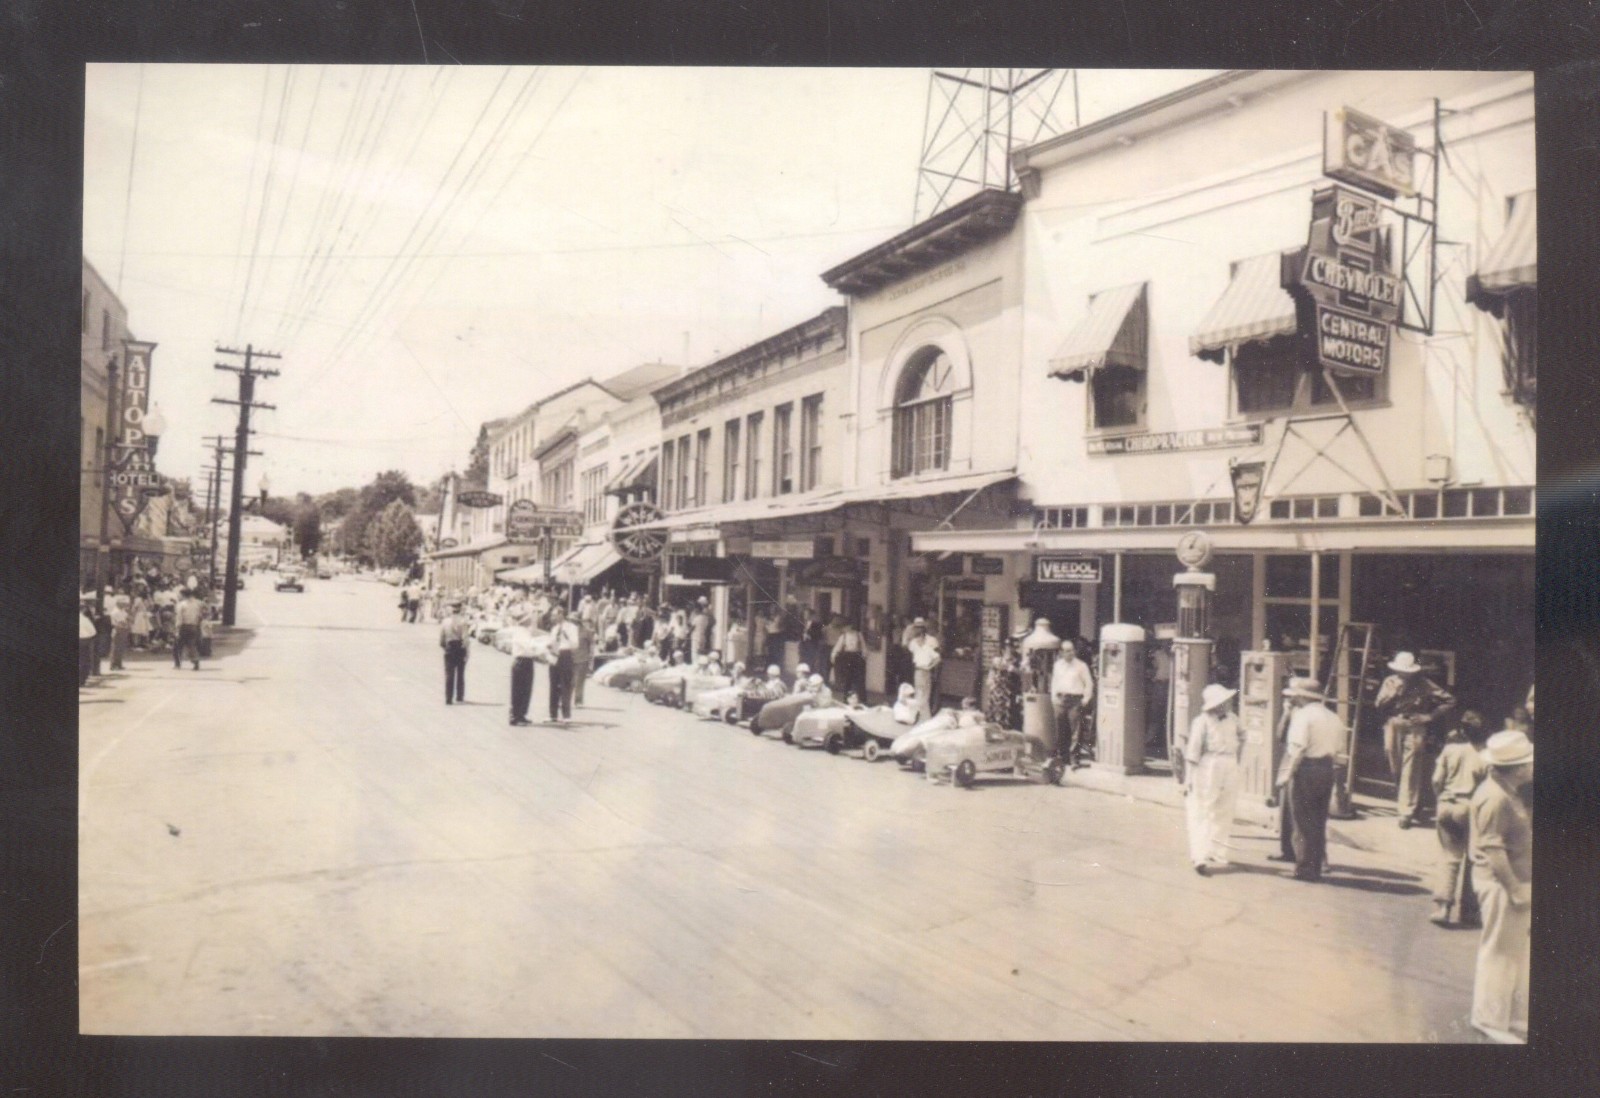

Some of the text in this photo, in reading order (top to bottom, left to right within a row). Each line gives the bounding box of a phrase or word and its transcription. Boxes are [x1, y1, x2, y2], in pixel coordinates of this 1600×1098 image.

[1311, 256, 1401, 307] CHEVROLET
[1321, 312, 1386, 346] CENTRAL
[1323, 336, 1382, 368] MOTORS
[1042, 561, 1098, 578] VEEDOL
